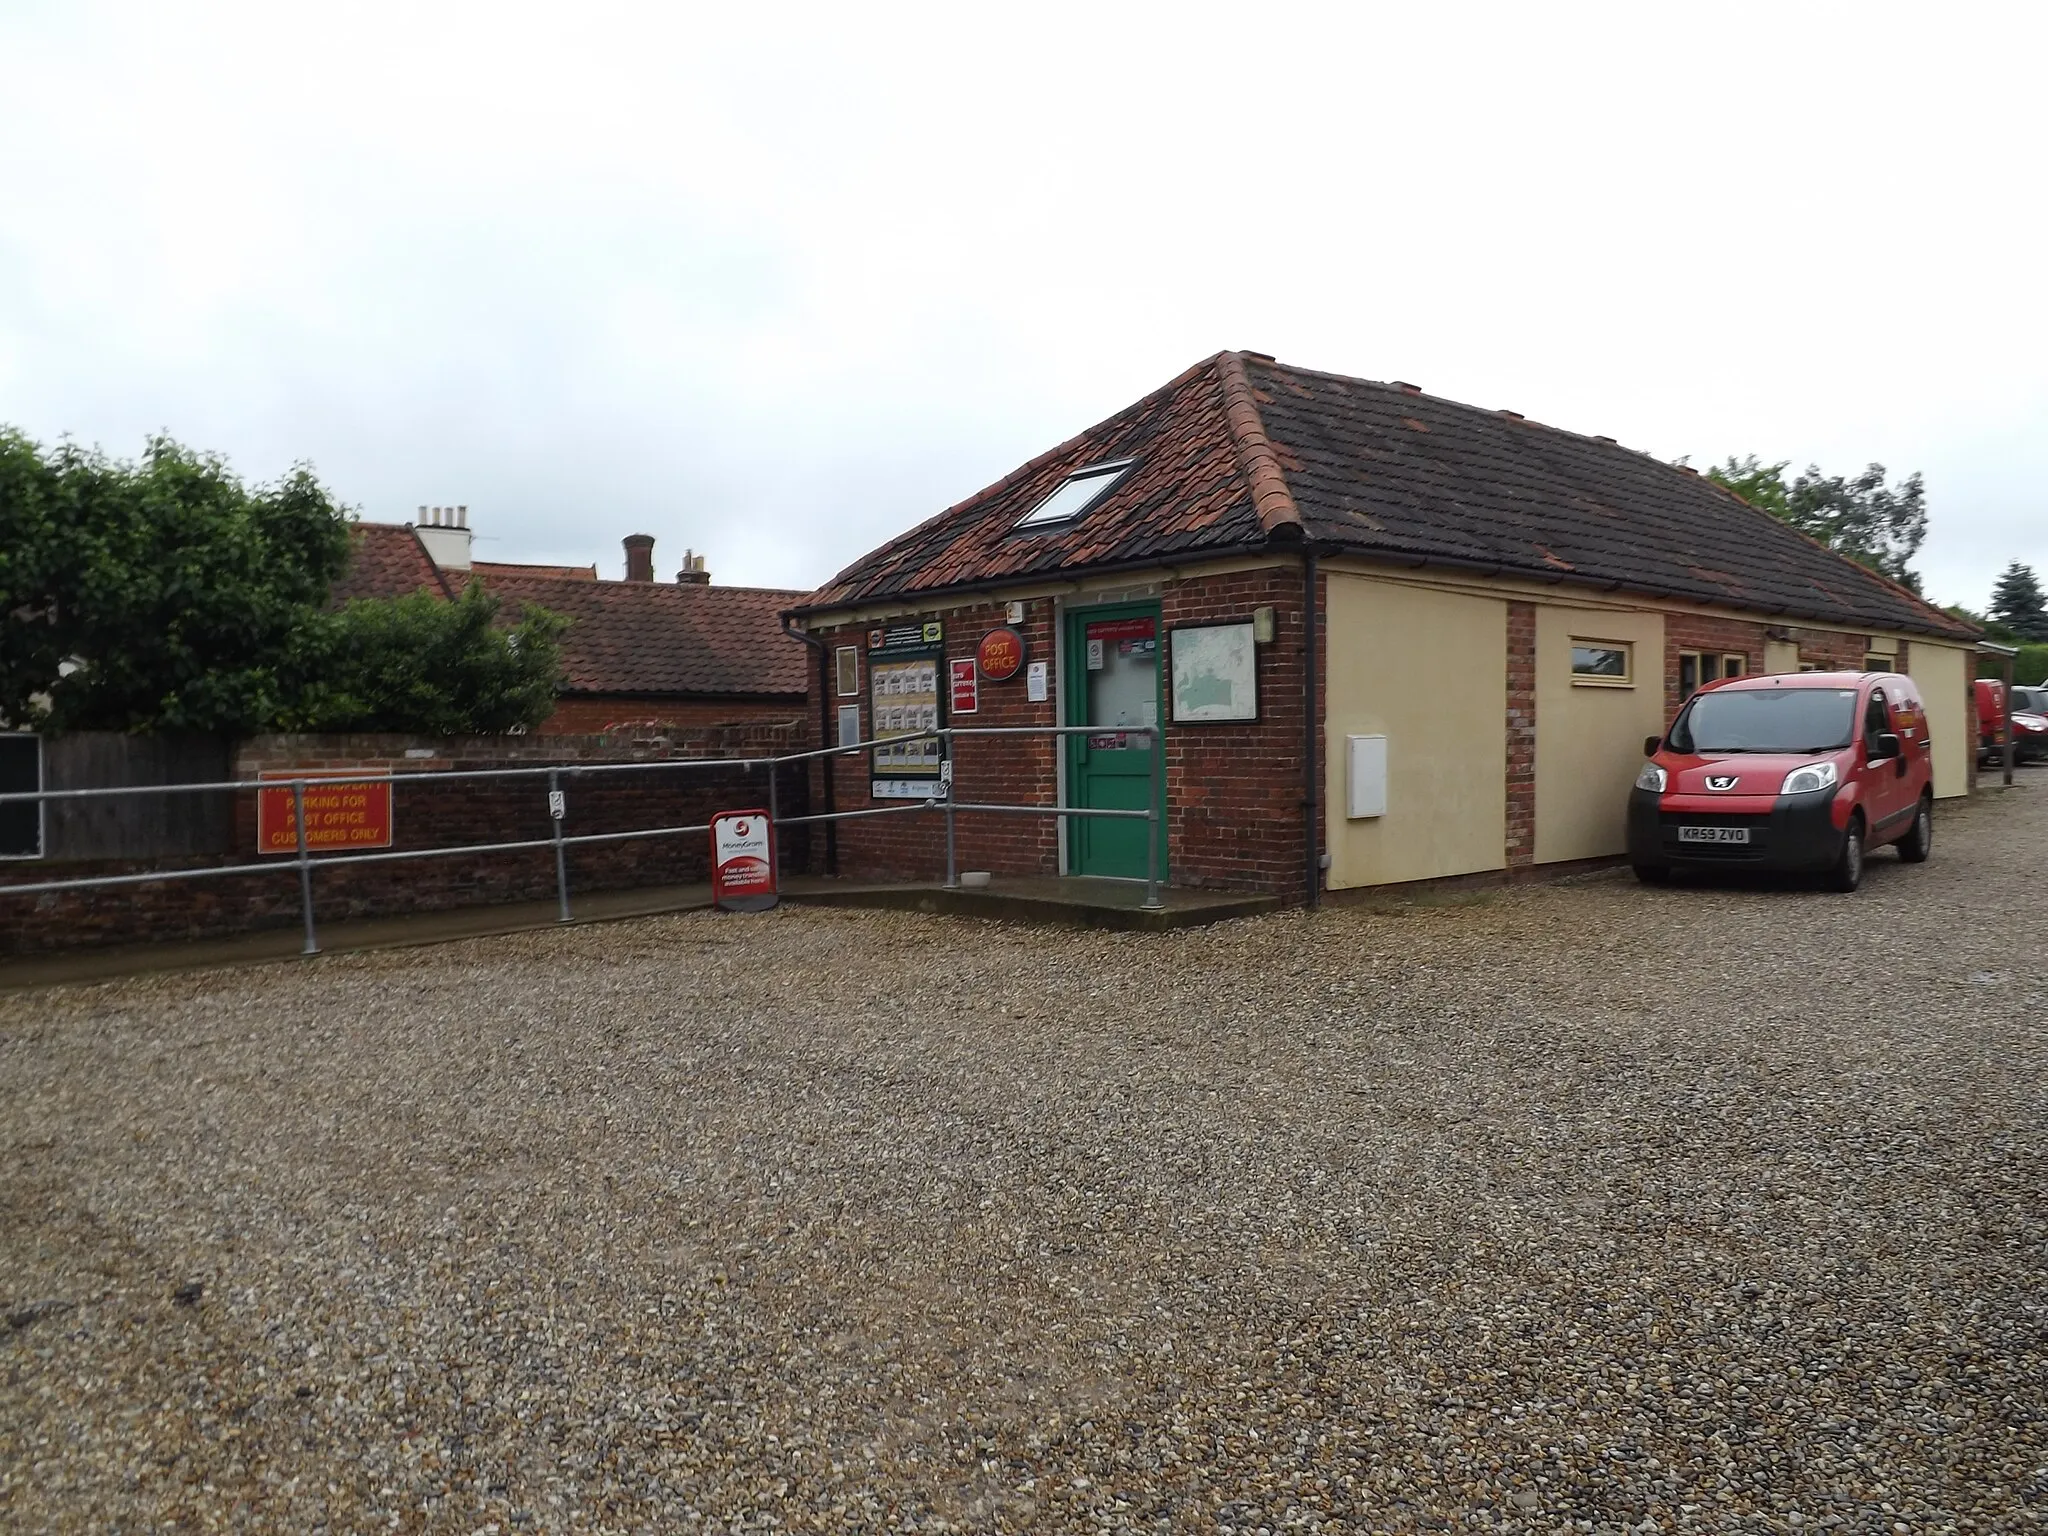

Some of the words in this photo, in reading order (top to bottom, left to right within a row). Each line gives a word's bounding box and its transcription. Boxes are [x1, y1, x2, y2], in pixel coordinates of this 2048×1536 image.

[985, 641, 1009, 656] POST
[982, 656, 1017, 672] OFFICE
[286, 796, 339, 810] PRKING
[342, 795, 367, 808] FOR
[286, 812, 320, 826] PST
[323, 811, 366, 825] OFFICE
[271, 830, 347, 845] CUSOMERS
[350, 827, 380, 840] ONLY
[1683, 828, 1716, 840] KR59
[1719, 829, 1744, 841] ZVO
[722, 841, 763, 850] MoneyGram
